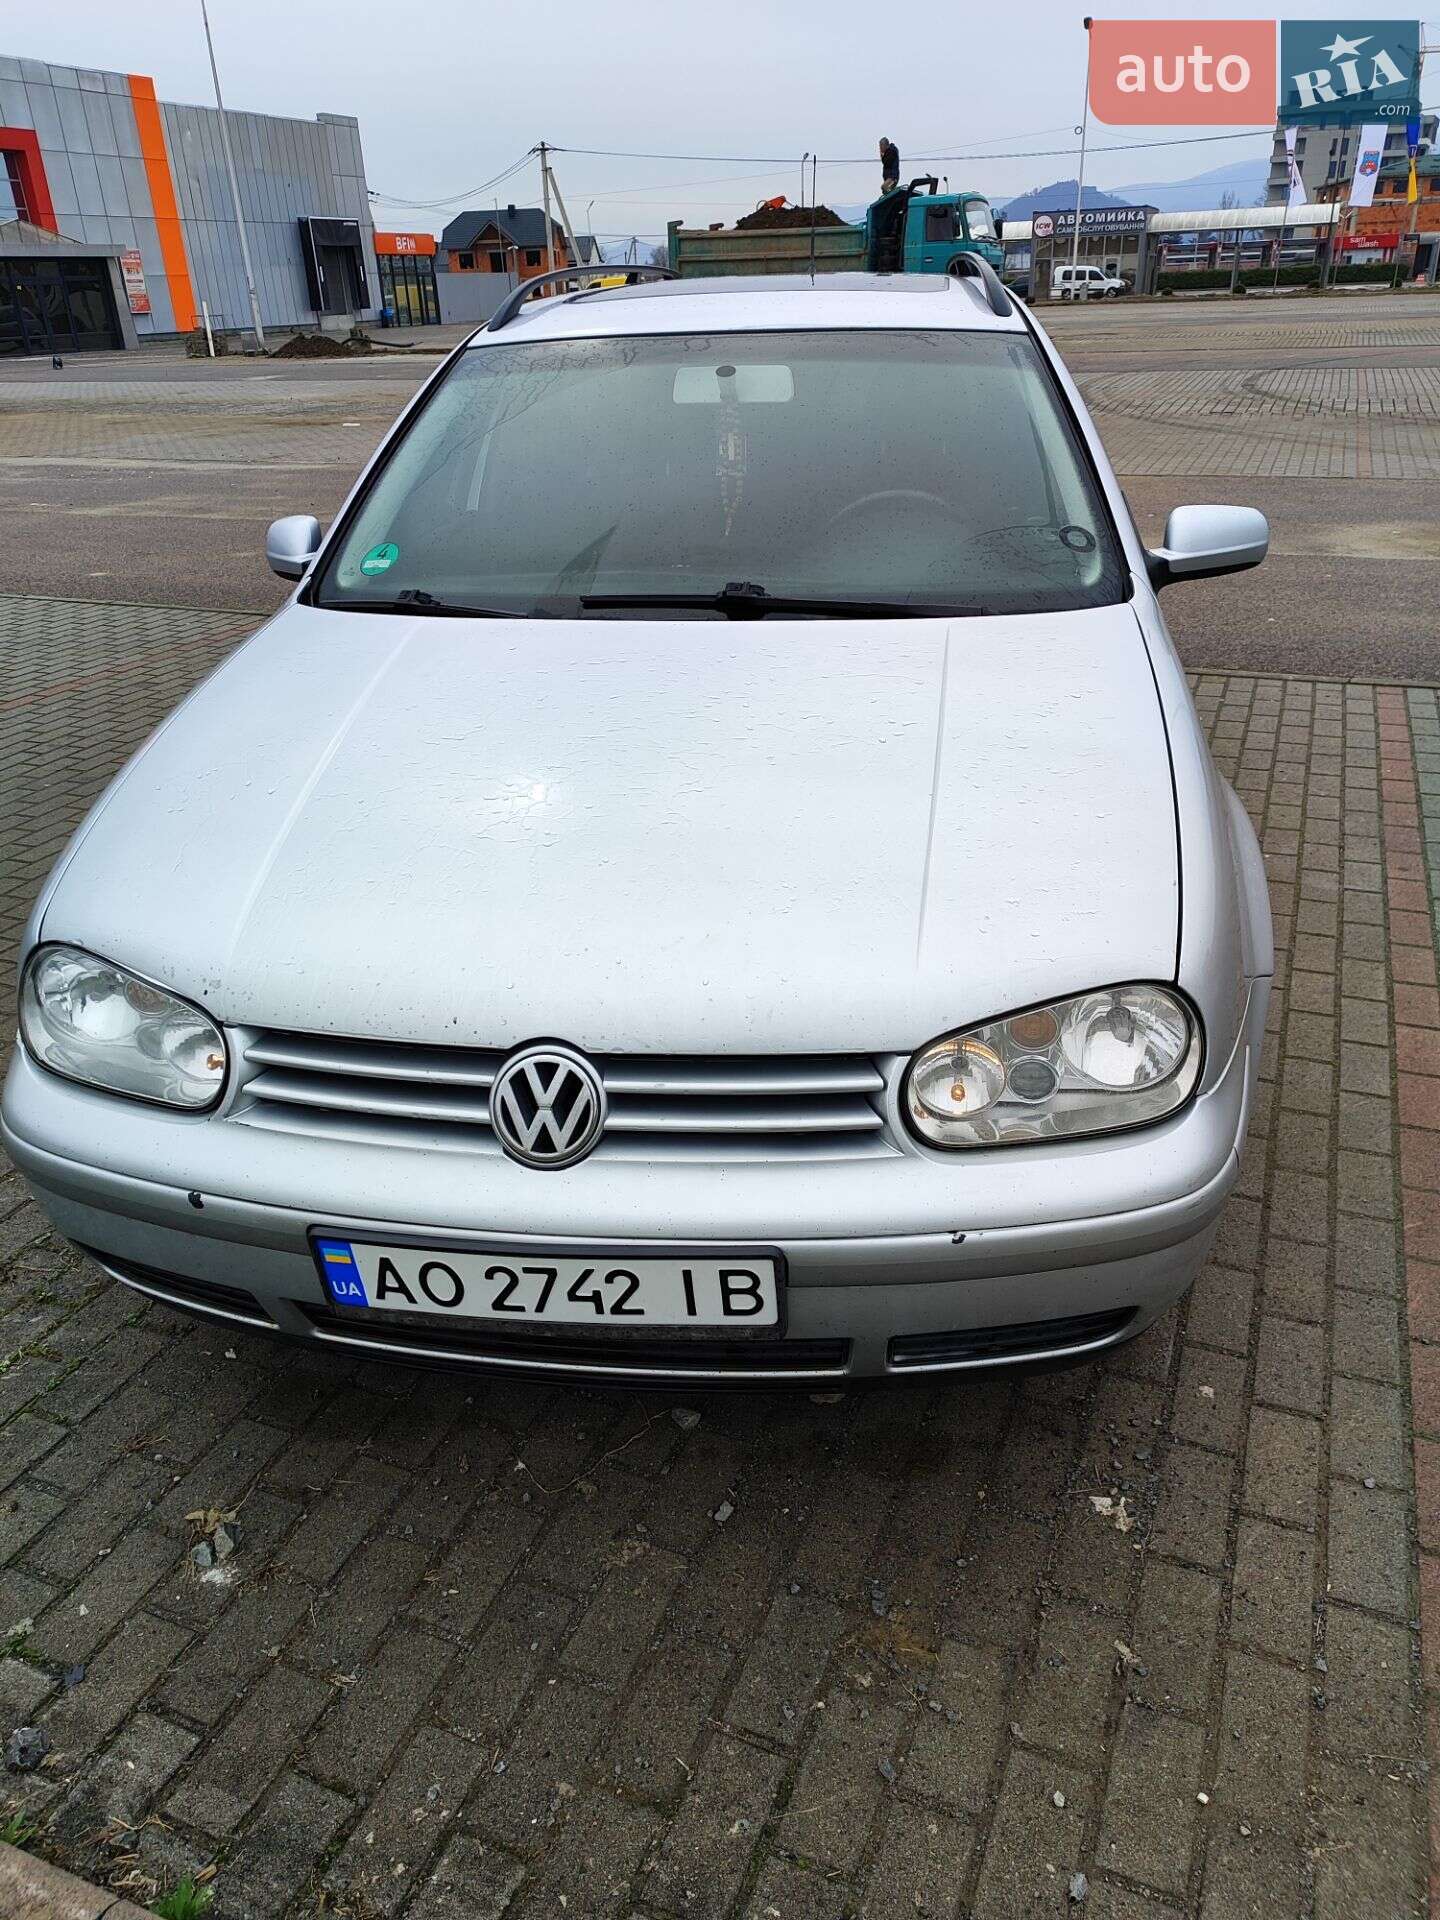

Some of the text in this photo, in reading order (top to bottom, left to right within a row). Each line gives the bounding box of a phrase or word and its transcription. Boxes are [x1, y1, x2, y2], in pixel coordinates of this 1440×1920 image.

[1057, 209, 1145, 225] АВТОМИЙКА
[333, 1281, 362, 1298] UA
[375, 1256, 765, 1318] AO 2742 IB
